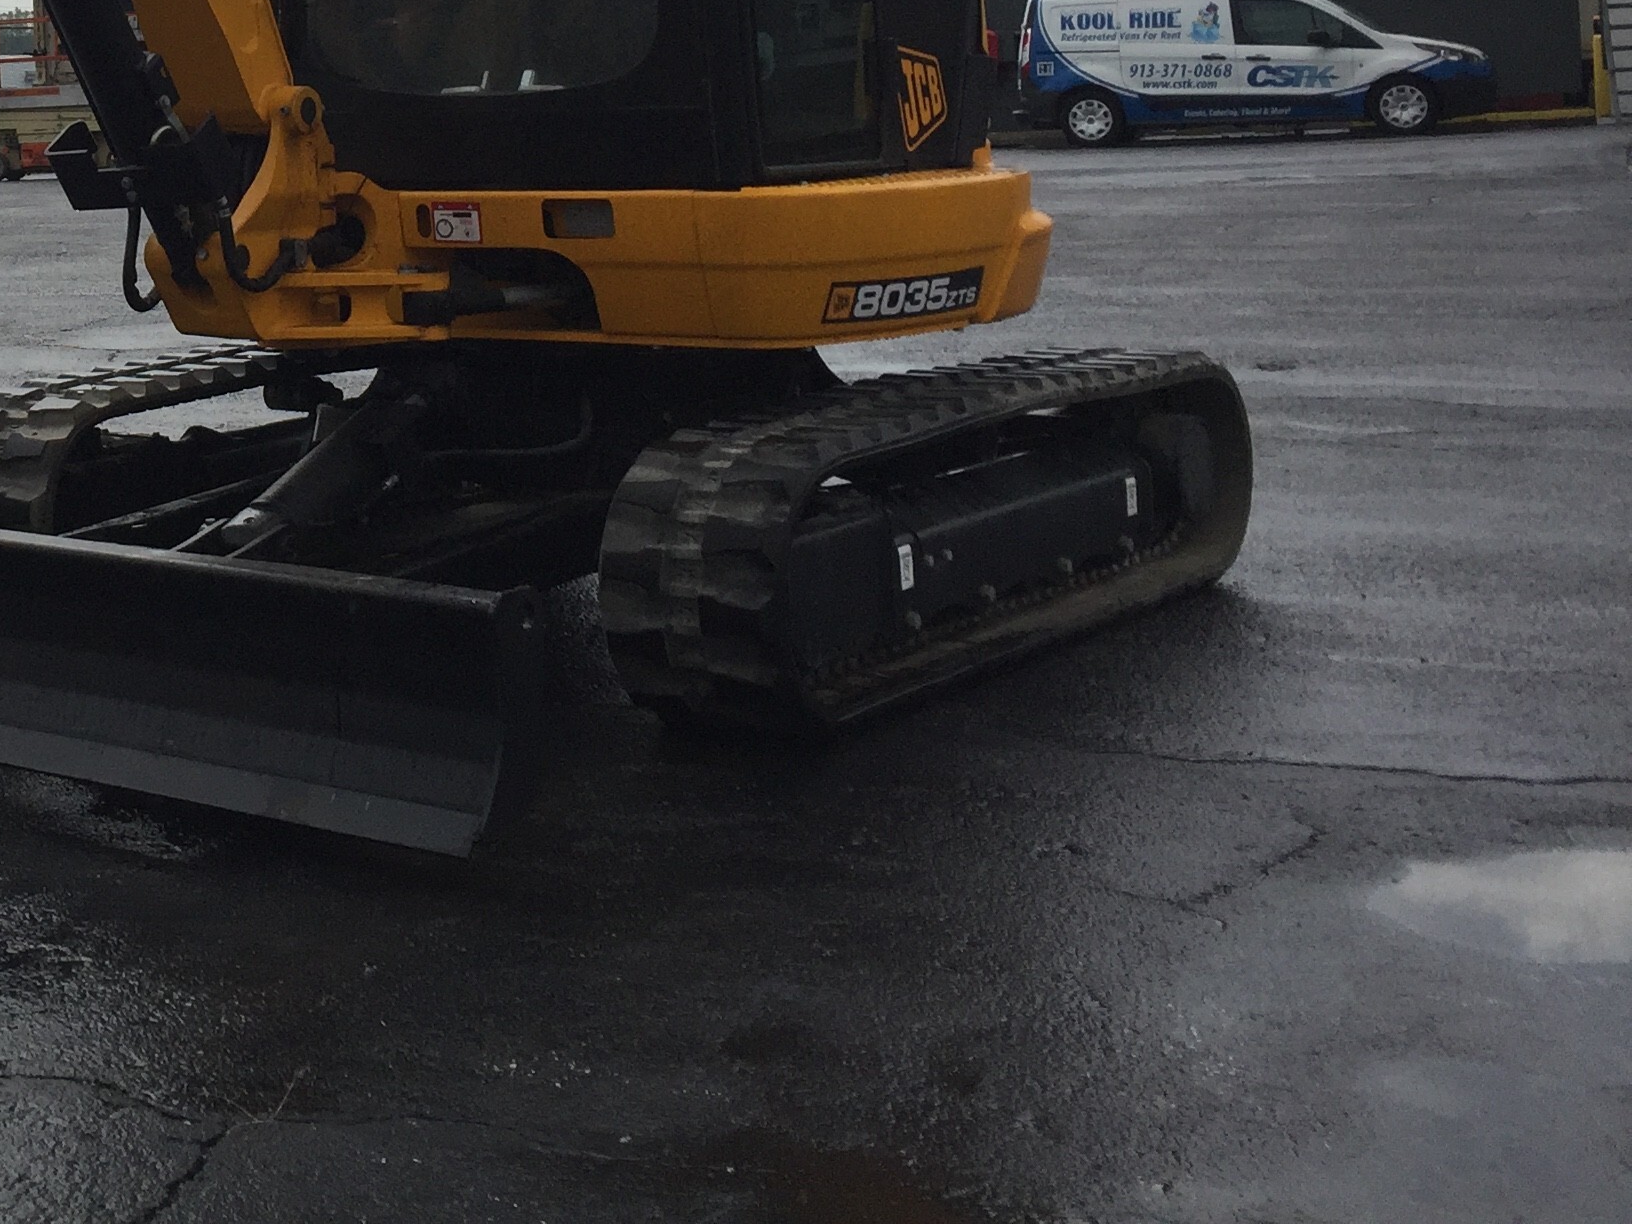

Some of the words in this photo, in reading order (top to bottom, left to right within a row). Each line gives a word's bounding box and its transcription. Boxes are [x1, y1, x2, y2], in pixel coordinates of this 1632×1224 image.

[1060, 10, 1120, 30] KOOL
[1129, 8, 1181, 28] RIDE
[1061, 33, 1117, 42] Refrigerated
[1129, 63, 1233, 78] 913-371-0868
[1247, 64, 1337, 88] CSTK
[1142, 79, 1217, 89] www.cstk.com
[900, 58, 943, 139] JCB
[853, 277, 951, 318] 8035
[946, 286, 977, 308] ZTS
